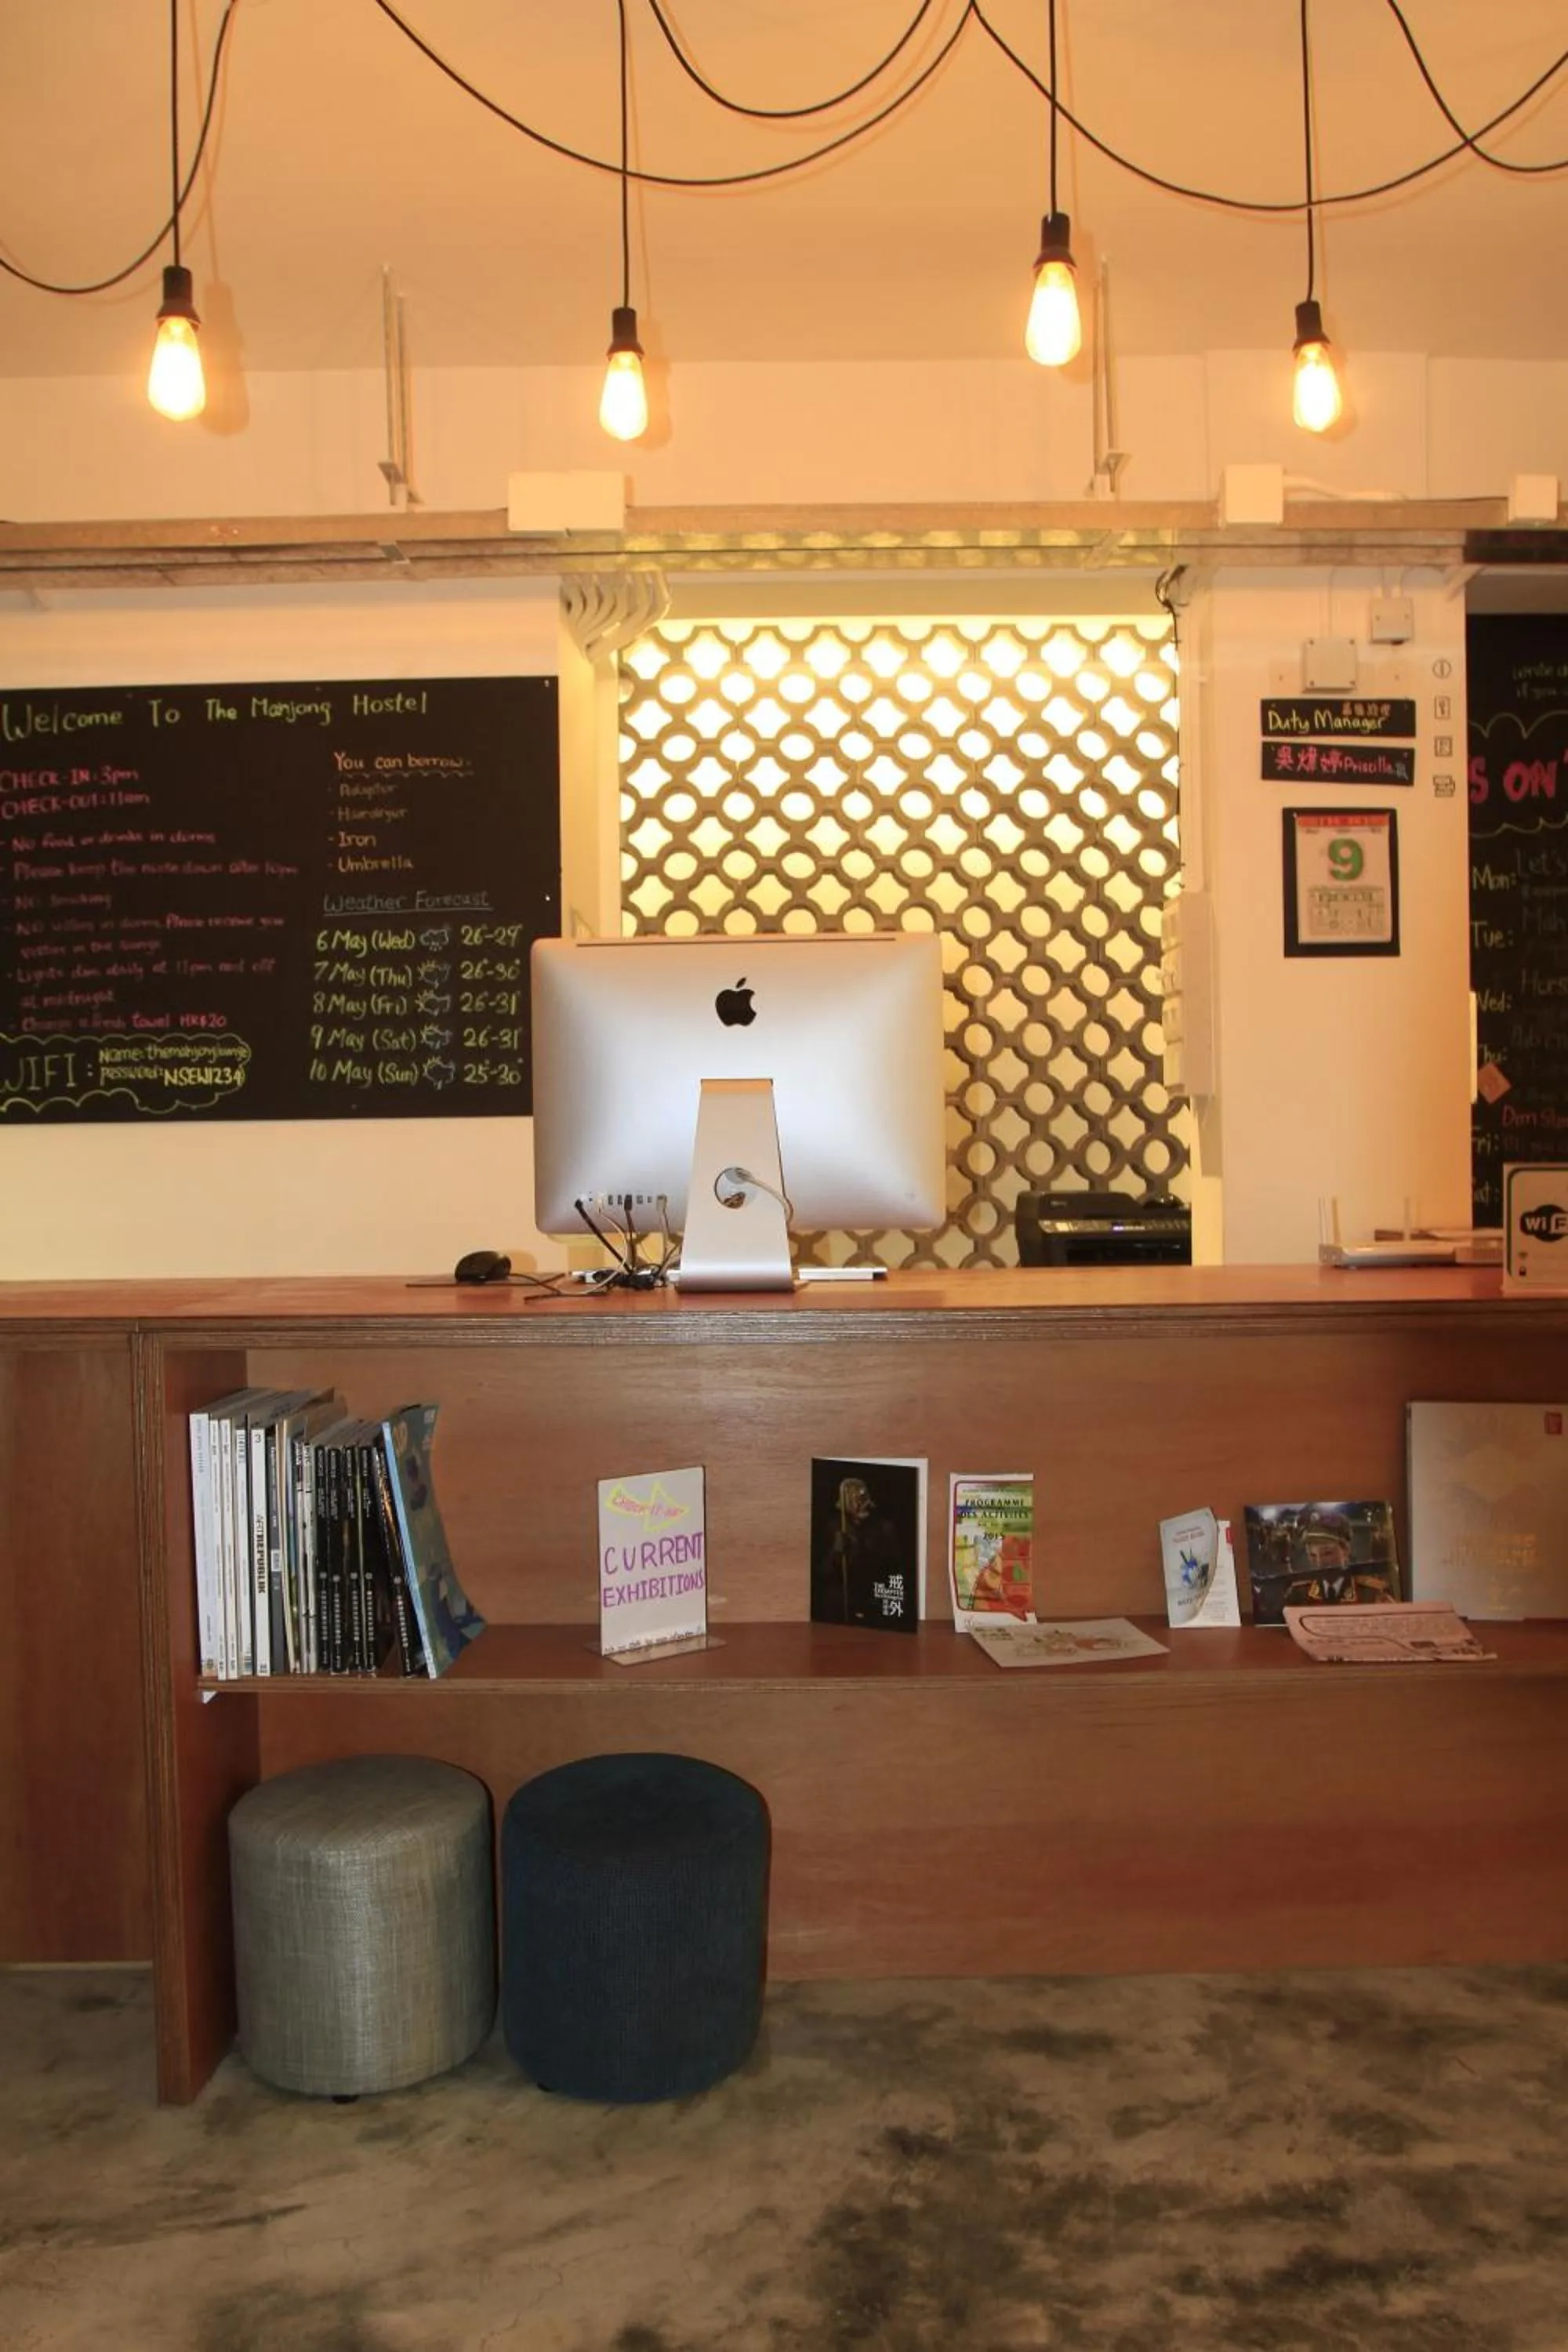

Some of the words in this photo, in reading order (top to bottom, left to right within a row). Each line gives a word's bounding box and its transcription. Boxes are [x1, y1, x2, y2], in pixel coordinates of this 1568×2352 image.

[2, 704, 123, 741] Welcome
[149, 699, 181, 728] To
[205, 698, 238, 721] The
[353, 691, 427, 716] Hostel
[1268, 708, 1310, 734] Duty
[1314, 708, 1386, 734] Manager
[334, 751, 365, 771] You
[374, 755, 402, 769] can
[1503, 758, 1557, 803] ON
[150, 831, 165, 841] in
[338, 831, 377, 848] Iron
[338, 855, 414, 873] Umbrella
[1327, 837, 1365, 881] 9
[323, 894, 408, 913] Weather
[415, 890, 490, 908] Forecast
[316, 930, 328, 950] 6
[332, 929, 368, 958] May
[372, 929, 416, 950] (Wed)
[314, 961, 329, 981] 7
[329, 961, 365, 986] May
[369, 964, 413, 987] (Thu)
[313, 990, 325, 1013] 8
[328, 993, 366, 1020] May
[371, 993, 407, 1015] (Fri)
[310, 1025, 323, 1050] 9
[327, 1028, 365, 1052] May
[372, 1029, 416, 1052] (Sat)
[1479, 1044, 1508, 1063] hu:
[309, 1058, 327, 1080] 10
[332, 1059, 372, 1088] May
[378, 1061, 419, 1086] (Sun)
[964, 1498, 1024, 1507] PROGRAMME
[604, 1531, 703, 1575] CURRENT
[603, 1568, 704, 1608] EXHIBITIONS
